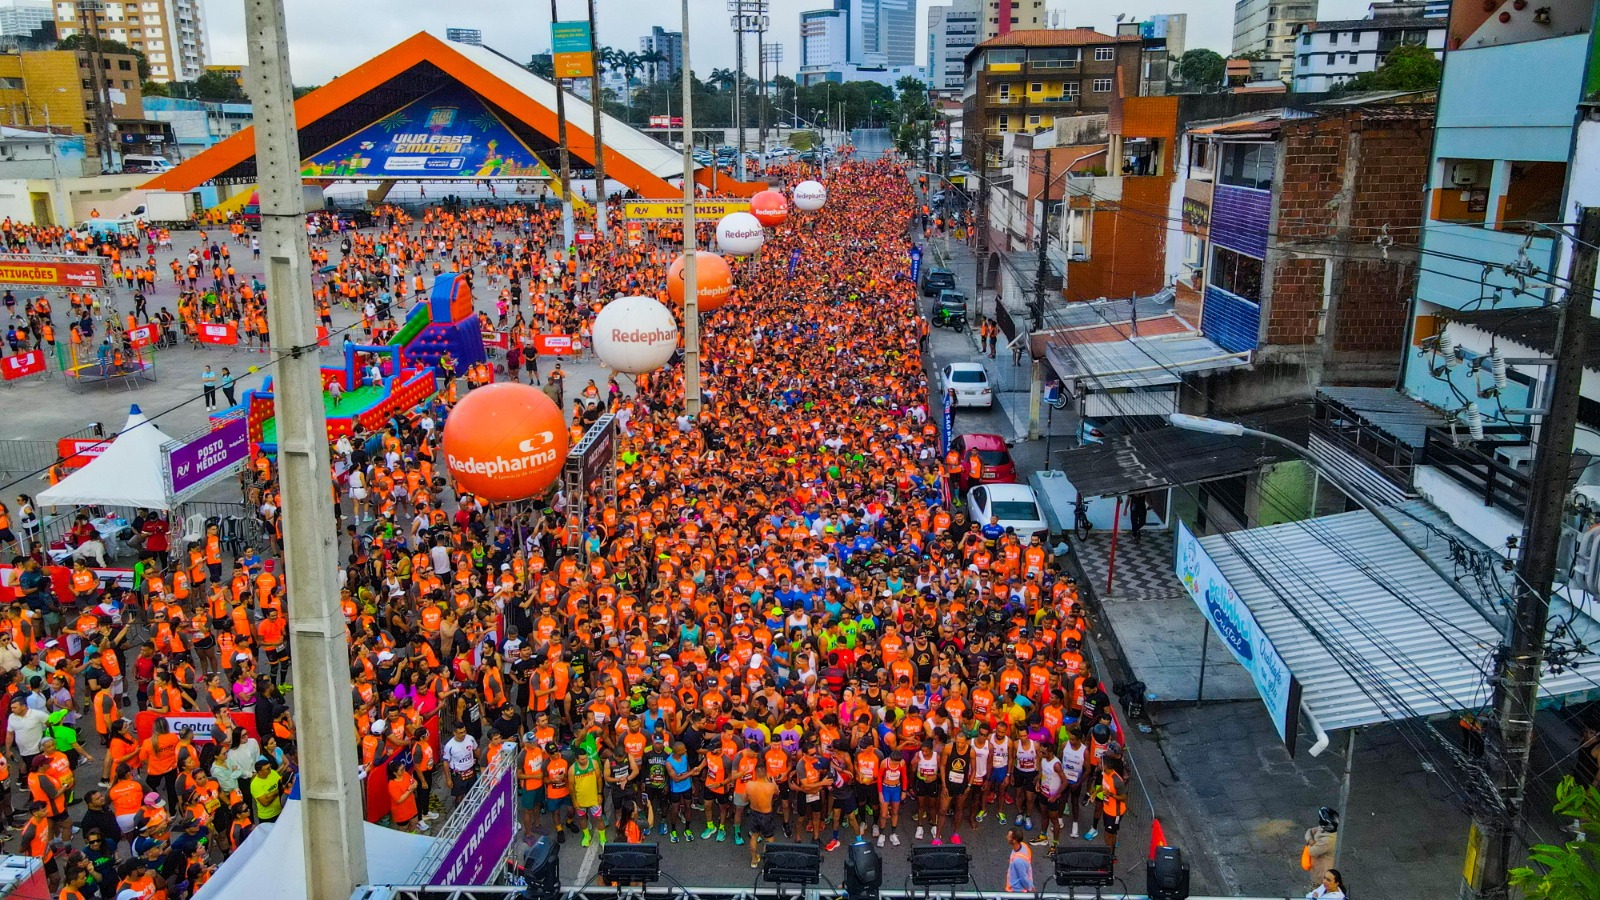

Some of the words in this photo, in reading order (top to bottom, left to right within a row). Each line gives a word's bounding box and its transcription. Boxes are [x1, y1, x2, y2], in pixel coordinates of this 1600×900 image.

[666, 206, 684, 214] KIT
[695, 206, 725, 214] INISH
[198, 439, 223, 460] POSTO
[196, 450, 227, 473] MÉDICO
[448, 449, 557, 478] Redepharma
[441, 791, 505, 885] METRAGEM
